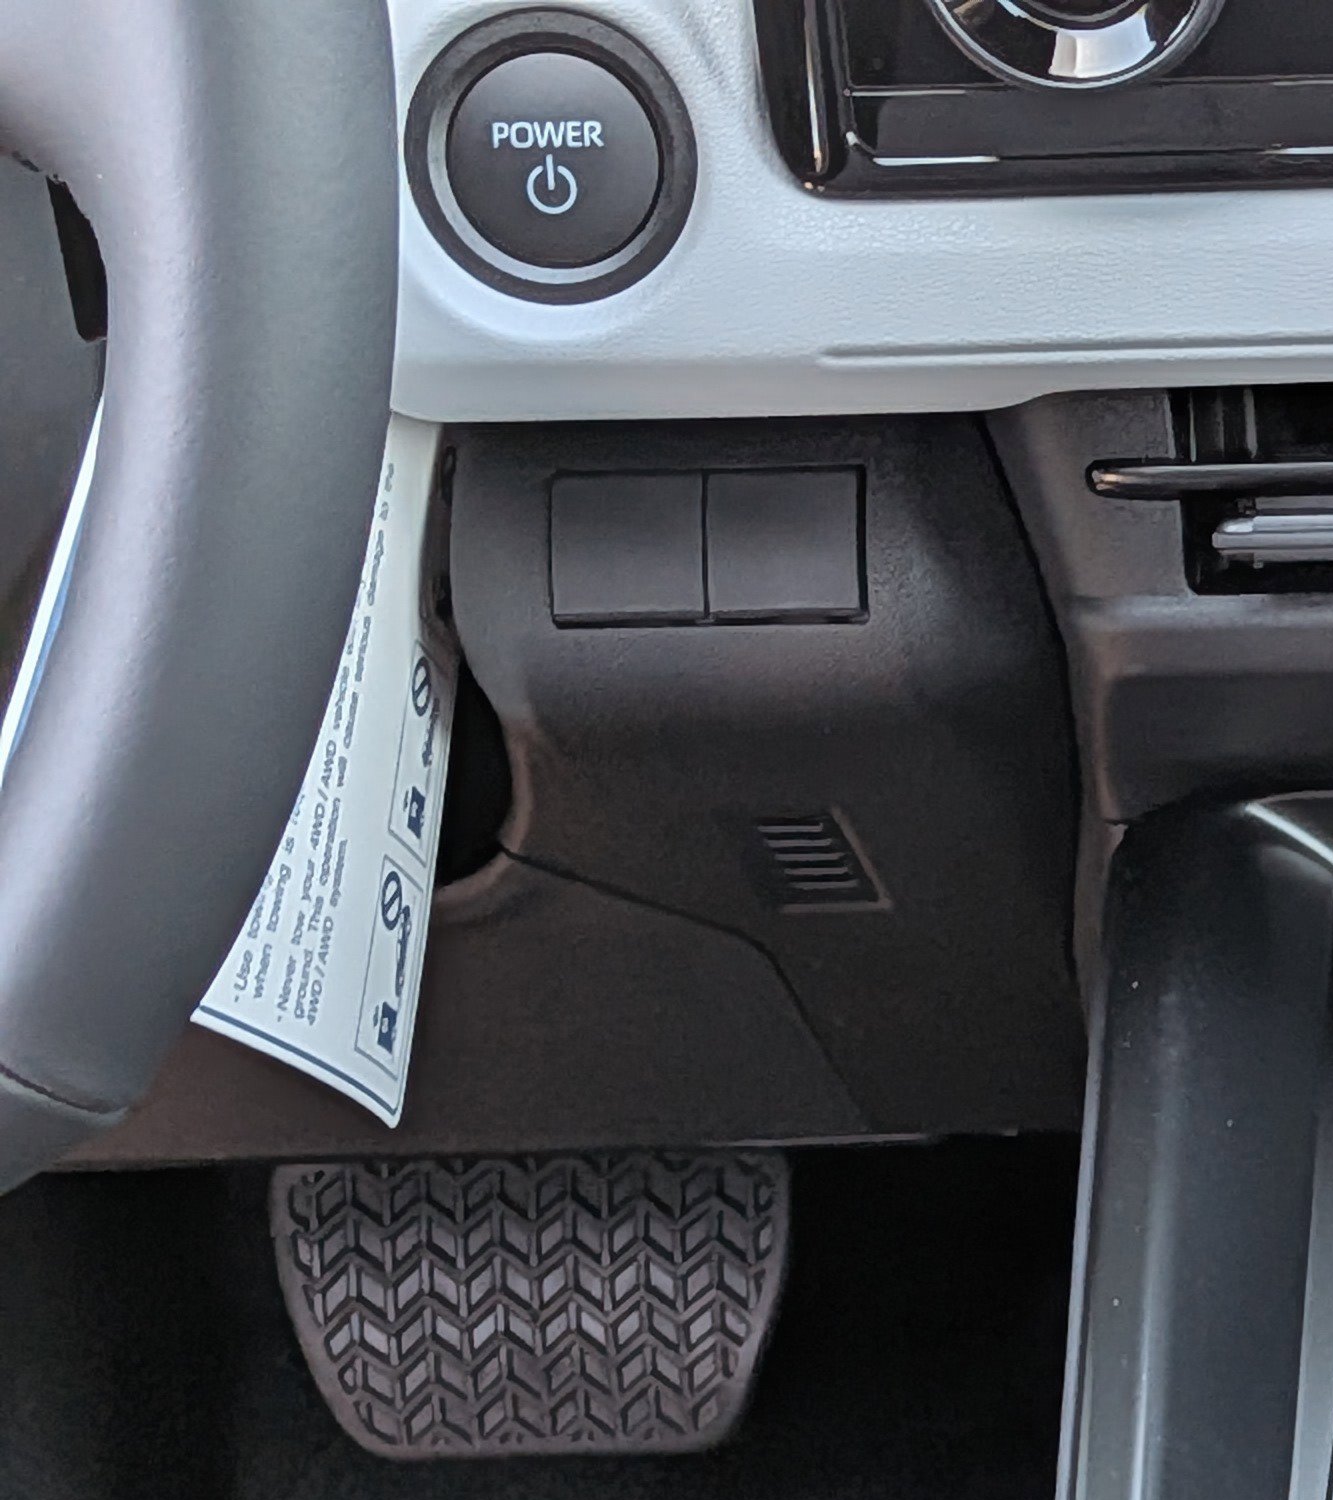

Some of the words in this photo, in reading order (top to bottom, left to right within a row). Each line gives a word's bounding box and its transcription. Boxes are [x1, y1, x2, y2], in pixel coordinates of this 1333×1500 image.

[492, 120, 605, 149] POWER
[234, 949, 253, 991] Use
[253, 943, 272, 999] when
[266, 863, 291, 933] towing
[277, 955, 297, 1011] Never
[291, 910, 305, 945] tow
[301, 858, 315, 902] your
[306, 980, 323, 1026] 4WD
[318, 915, 334, 965] AWD
